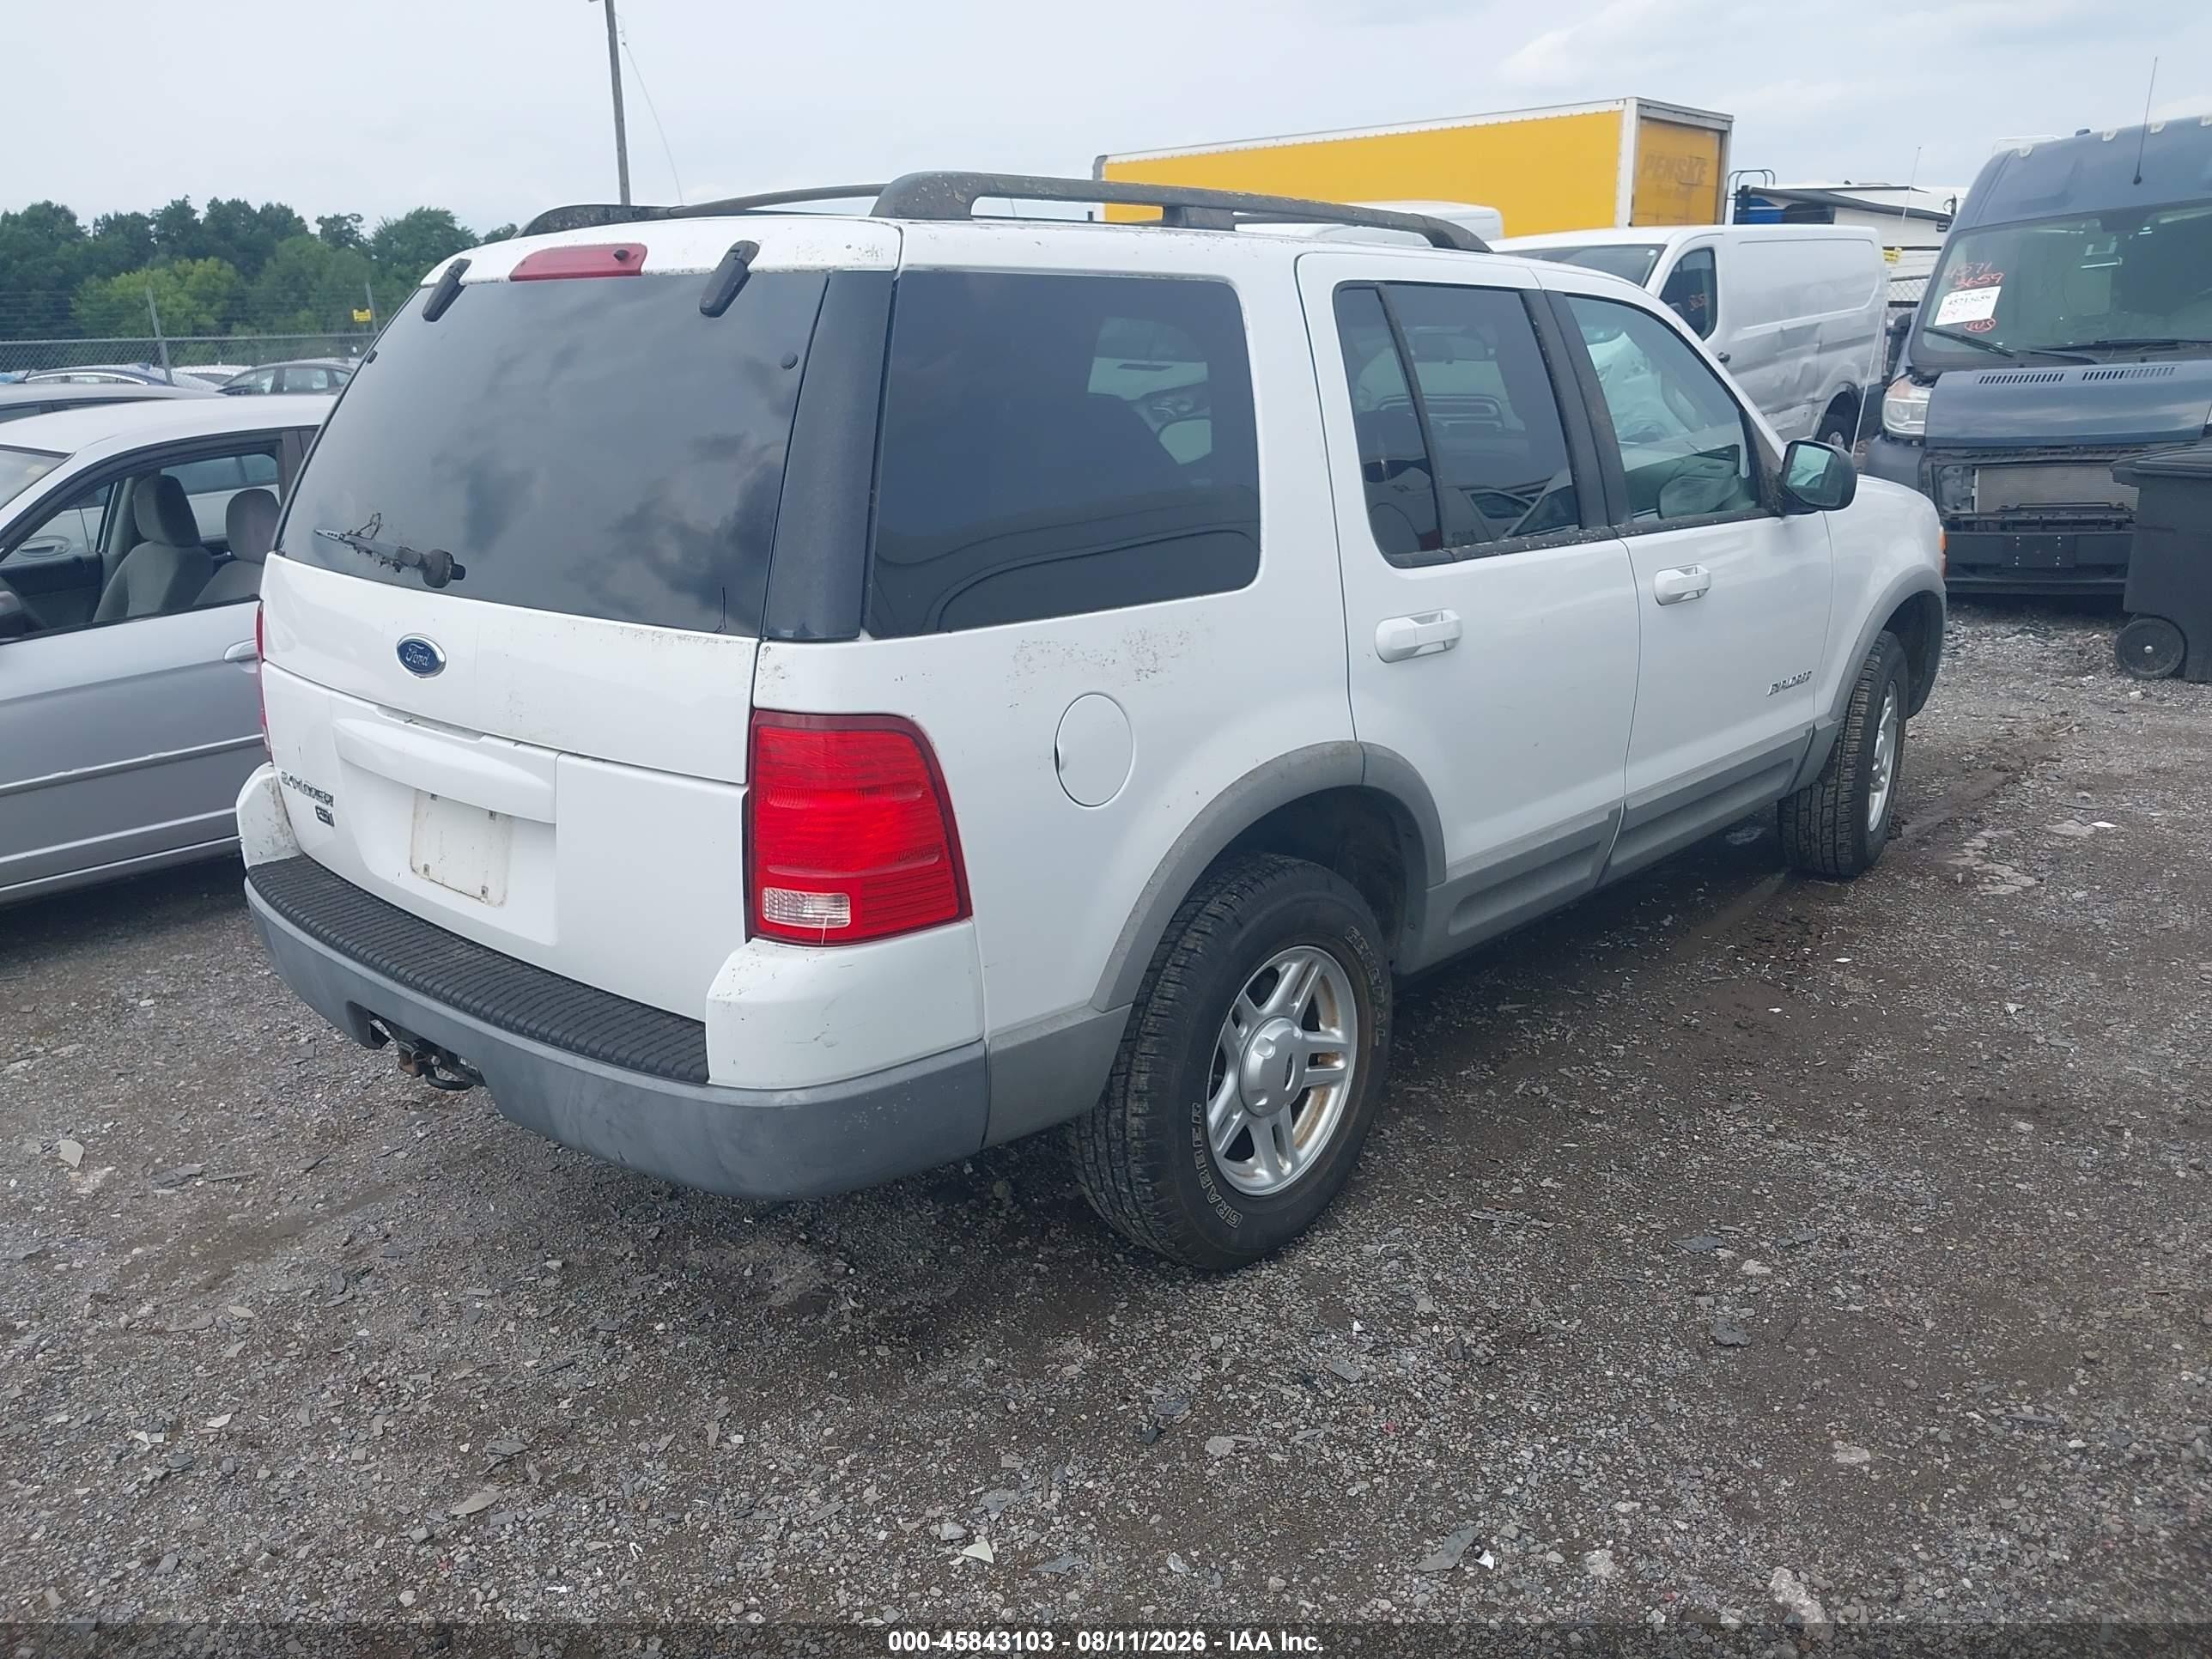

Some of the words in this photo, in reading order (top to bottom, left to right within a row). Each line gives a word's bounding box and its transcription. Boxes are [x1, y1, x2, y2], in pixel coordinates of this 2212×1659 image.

[1639, 151, 1707, 185] PENSKE
[405, 642, 431, 667] Ford
[1345, 925, 1388, 1047] GENERAL
[1191, 1102, 1243, 1228] GRABBER
